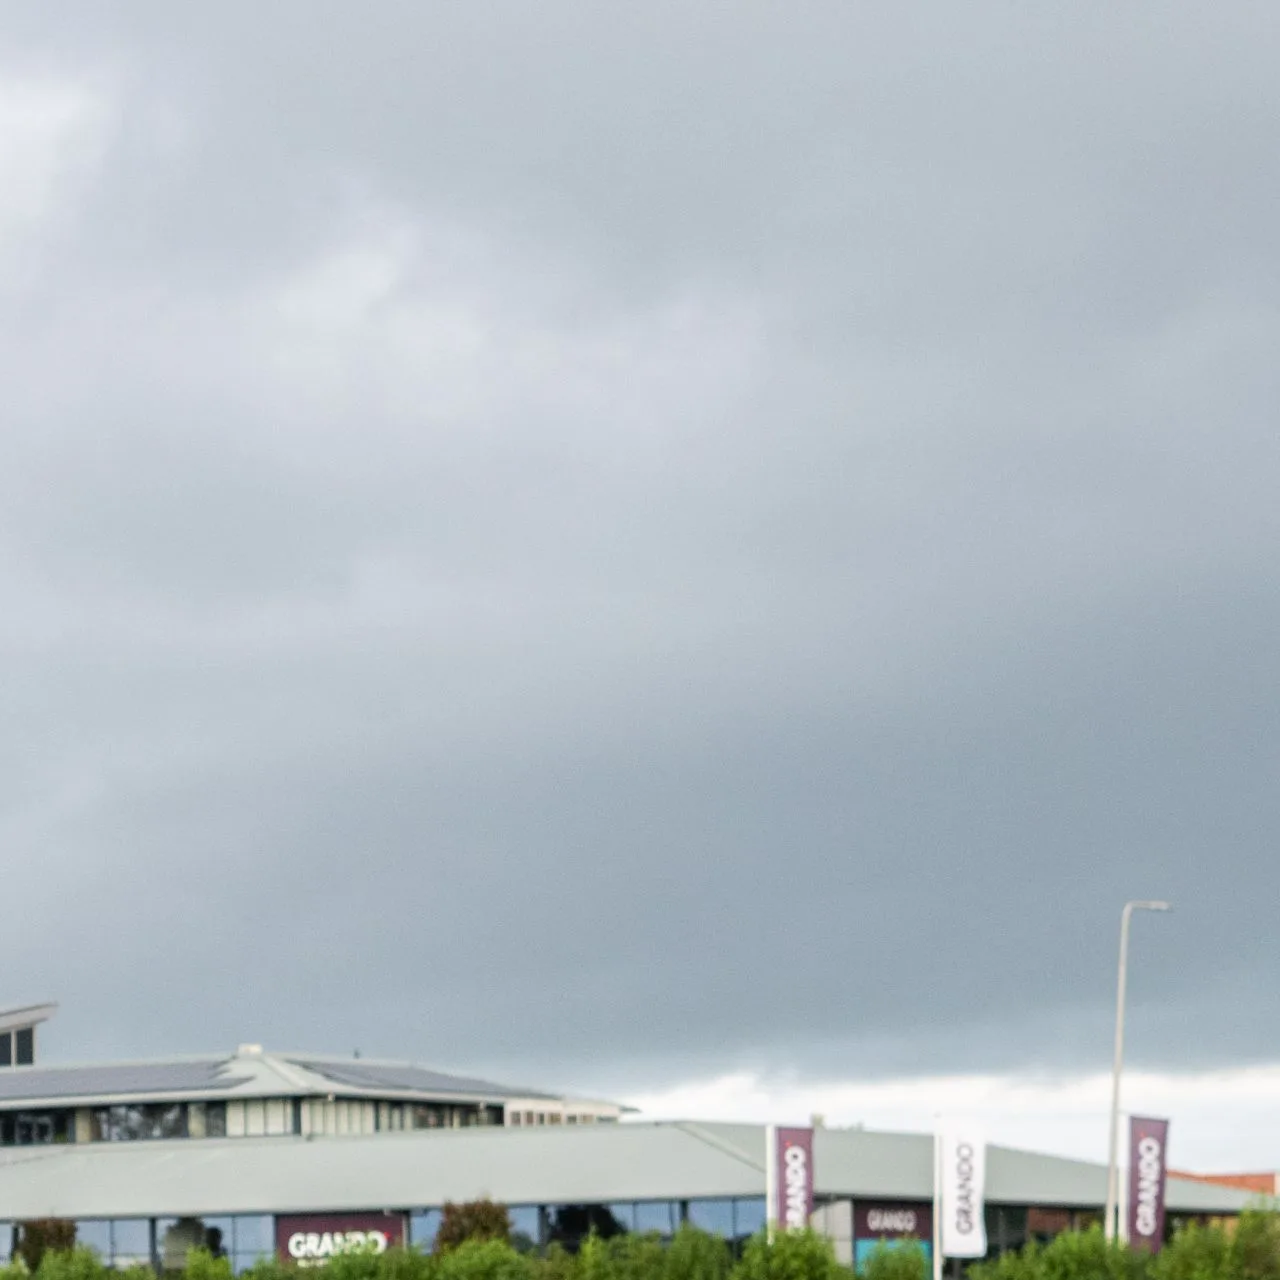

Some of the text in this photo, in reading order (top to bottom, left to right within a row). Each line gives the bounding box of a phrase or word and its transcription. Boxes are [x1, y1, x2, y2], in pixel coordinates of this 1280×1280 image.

[867, 1208, 917, 1232] GRANDO
[955, 1143, 974, 1235] GRANDO
[1136, 1137, 1161, 1236] GRANDO
